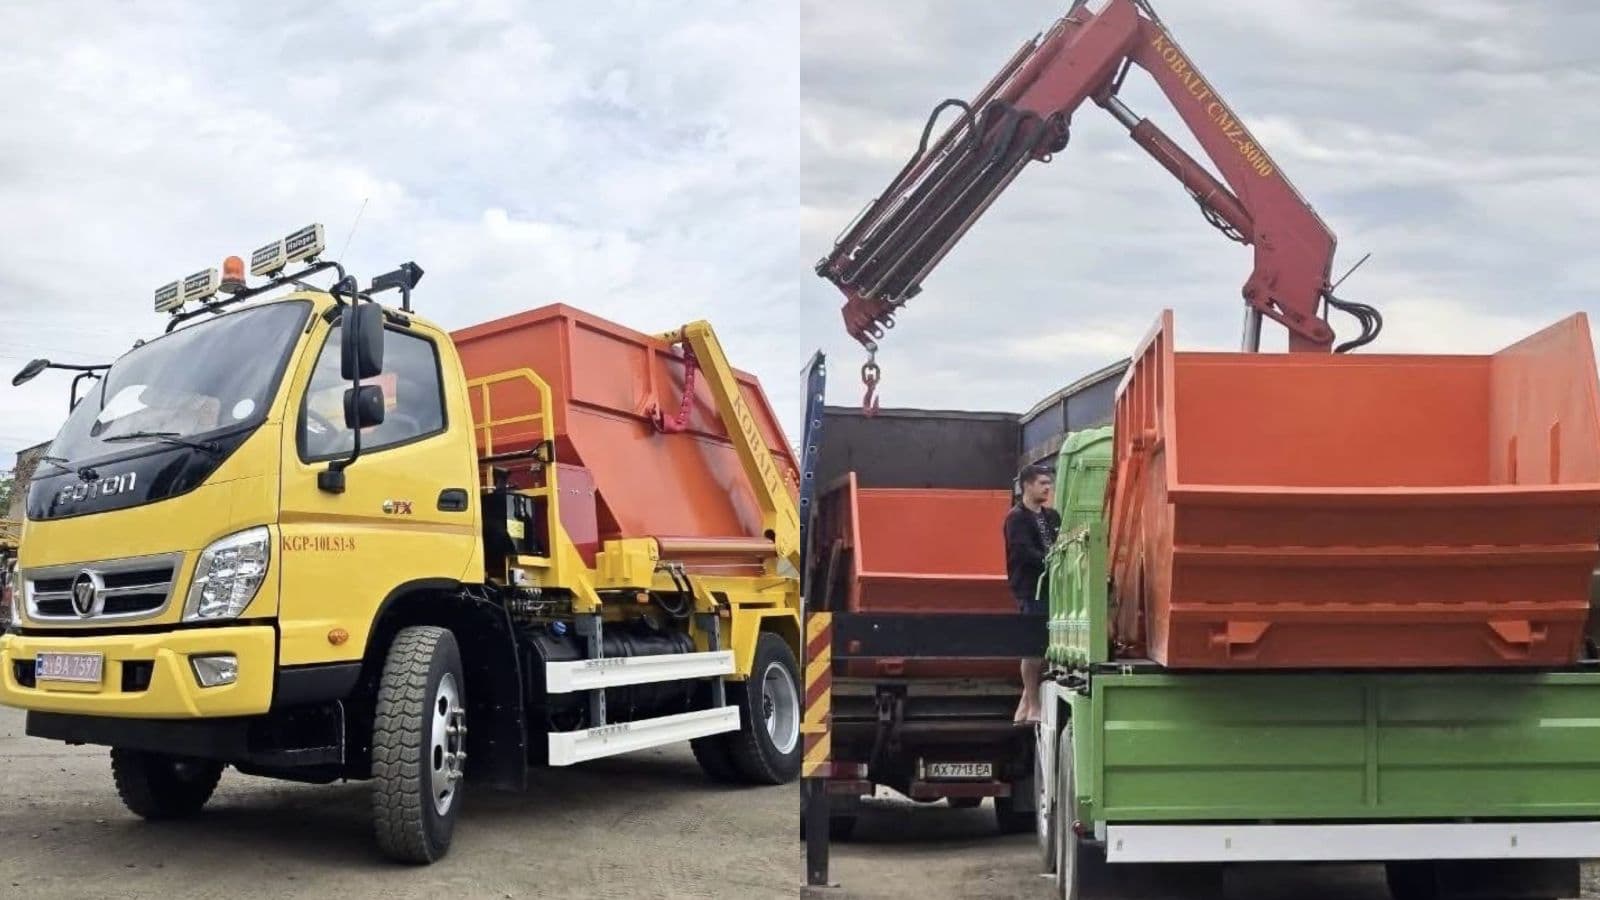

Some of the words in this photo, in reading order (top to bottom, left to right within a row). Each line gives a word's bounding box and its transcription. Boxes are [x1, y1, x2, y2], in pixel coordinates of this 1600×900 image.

[1152, 34, 1212, 101] KOBALT
[1208, 102, 1273, 177] CMZ-8000
[287, 233, 316, 251] Halogen
[733, 395, 779, 494] KOBALT
